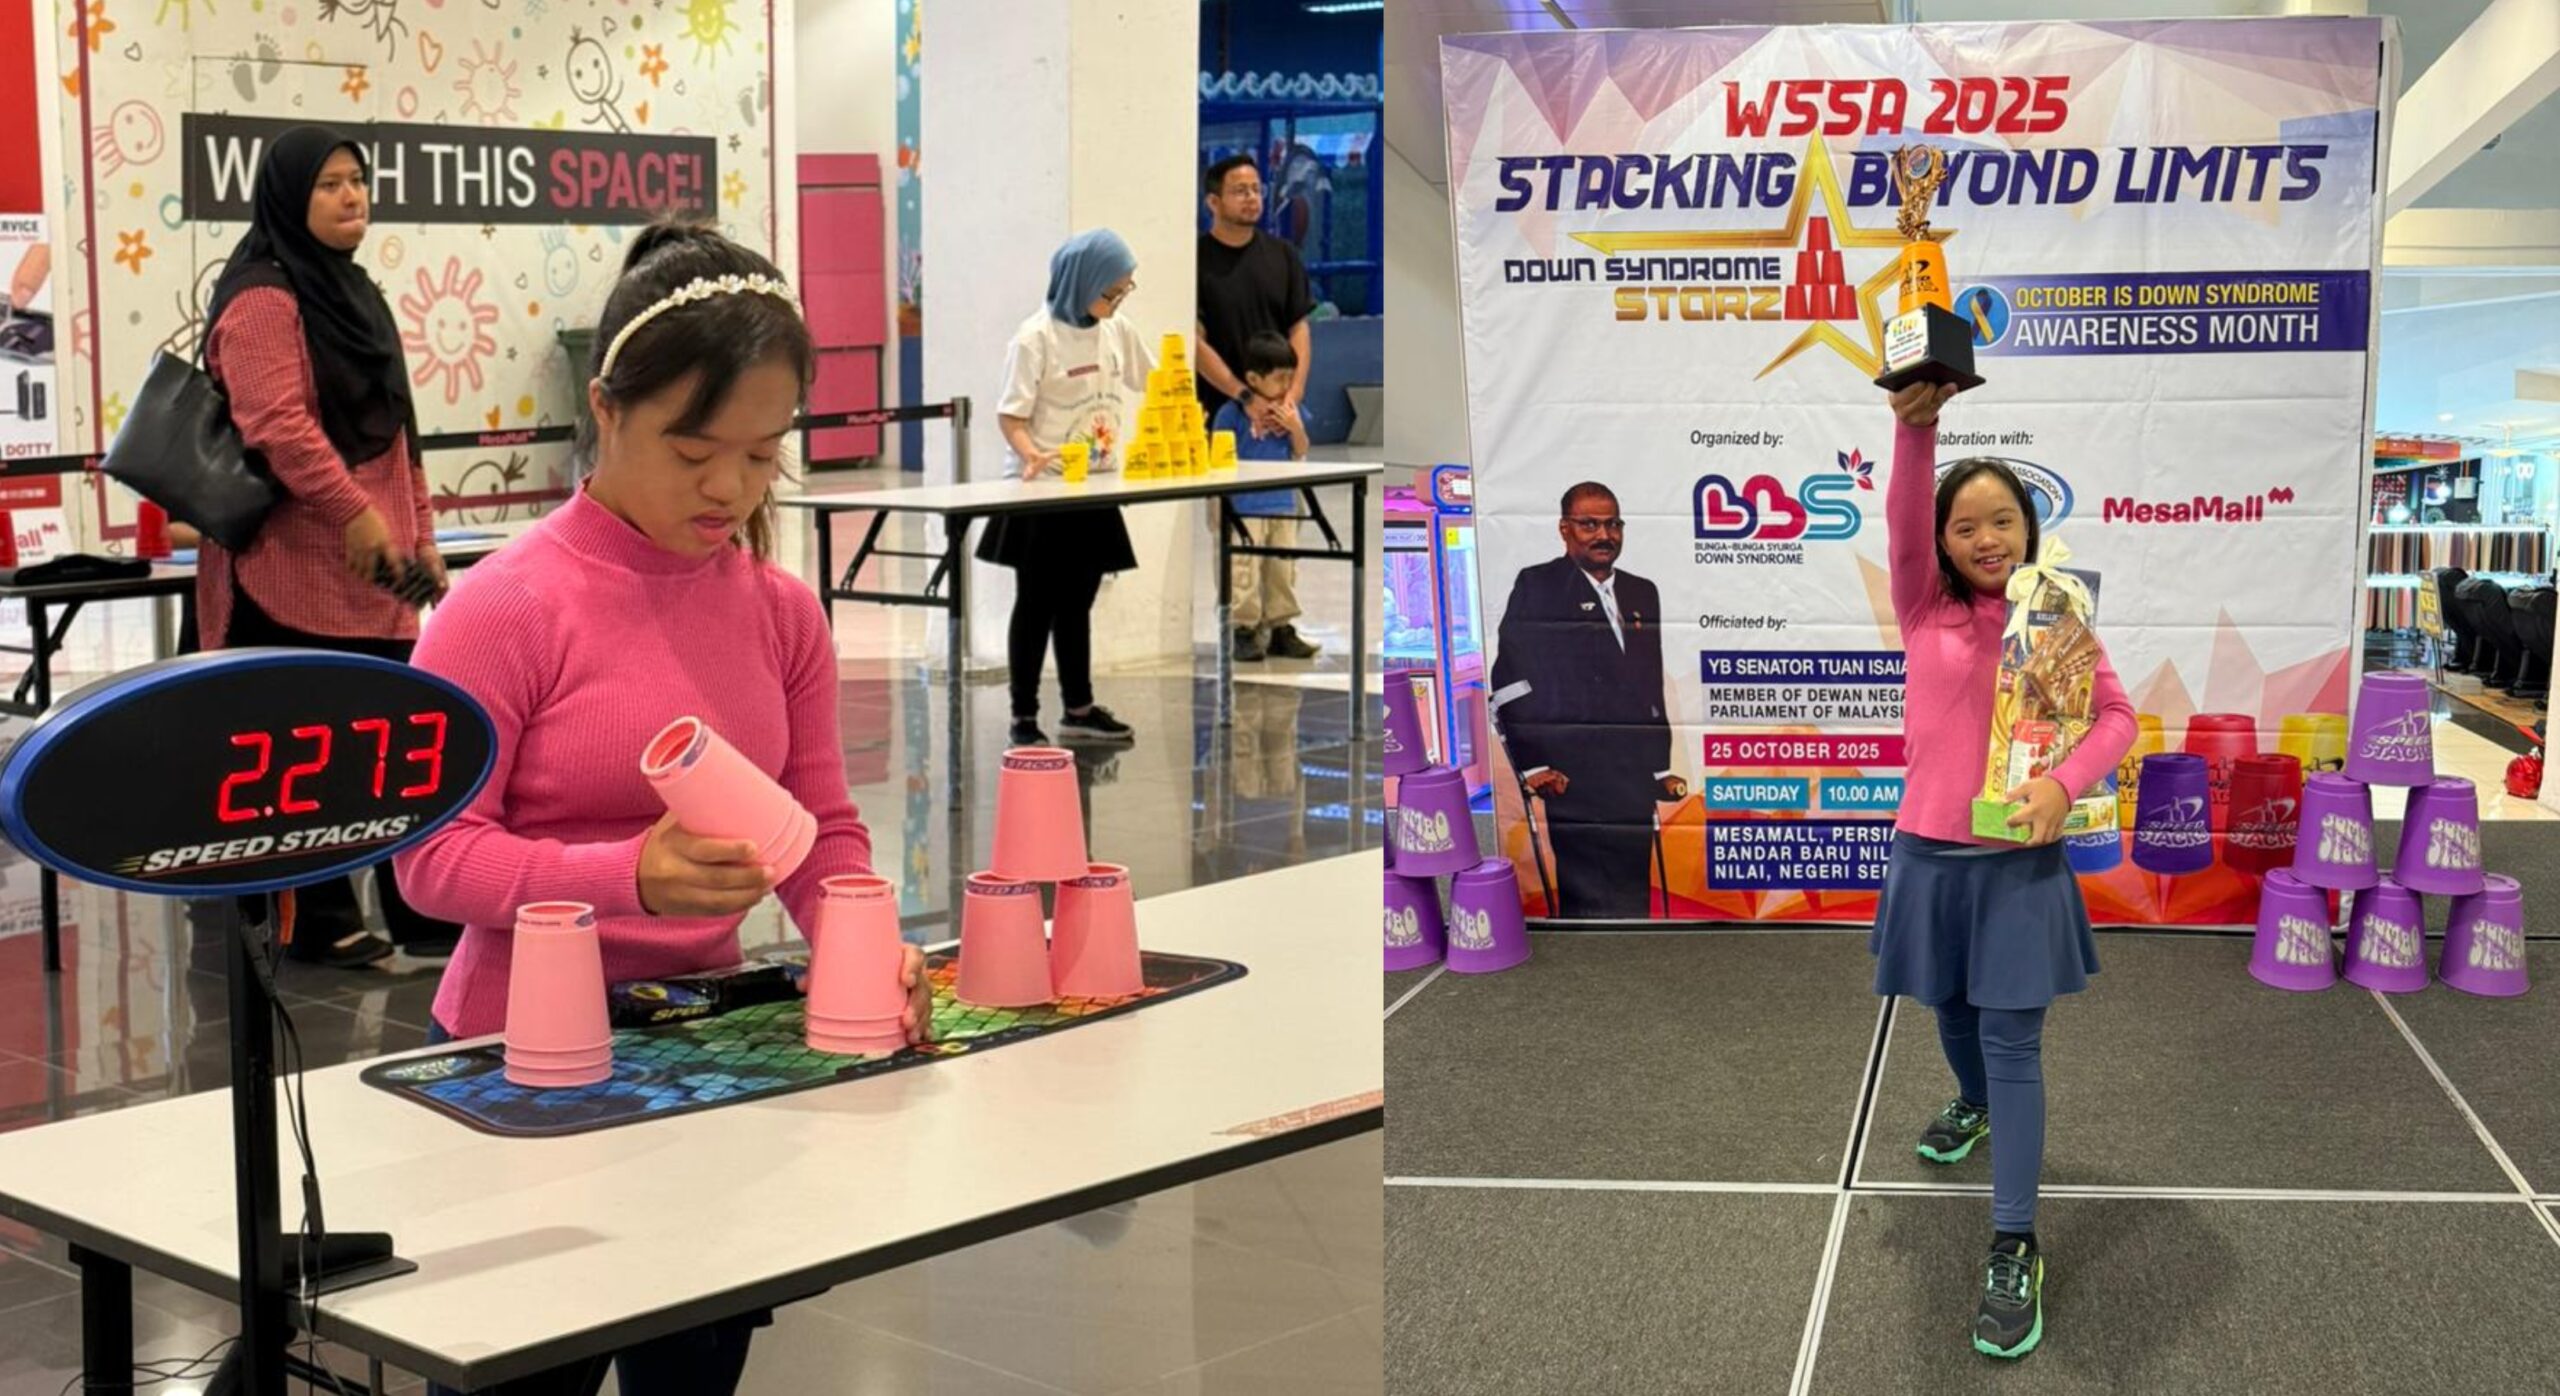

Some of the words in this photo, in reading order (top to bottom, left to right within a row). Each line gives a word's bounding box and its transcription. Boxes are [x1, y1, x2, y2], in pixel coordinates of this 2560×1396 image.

[1722, 78, 1910, 138] WSSA
[1923, 75, 2070, 135] 2025
[420, 142, 537, 208] THIS
[549, 148, 702, 208] SPACE!
[1495, 151, 1797, 212] STACKING
[2113, 144, 2328, 204] LIMITS
[1, 220, 39, 232] RVICE
[1504, 258, 1596, 283] DOWN
[1605, 256, 1781, 281] SYNDROME
[1614, 286, 1782, 321] STARZ
[2016, 286, 2107, 308] OCTOBER
[2113, 285, 2133, 306] IS
[2139, 284, 2200, 306] DOWN
[2205, 283, 2320, 305] SYNDROME
[2014, 315, 2199, 347] AWARENESS
[2208, 313, 2319, 344] MONTH
[1690, 430, 1760, 448] Organized
[1763, 430, 1784, 448] by:
[1999, 430, 2034, 445] with:
[5, 443, 52, 456] DOTTY
[2103, 495, 2264, 523] MesaMall
[1694, 542, 1764, 551] BUNGA-BUNGA
[1767, 542, 1804, 551] SYURGA
[1695, 553, 1734, 564] DOWN
[1736, 553, 1804, 564] SYNDROME
[1699, 614, 1764, 629] Officiated
[1767, 615, 1788, 632] by:
[1708, 658, 1731, 675] YB
[1736, 658, 1814, 675] SENATOR
[1818, 658, 1864, 675] TUAN
[1710, 688, 1776, 702] MEMBER
[1782, 688, 1802, 702] OF
[1808, 688, 1862, 702] DEWAN
[1711, 705, 1808, 719] PARLIAMENT
[1813, 705, 1833, 719] OF
[1711, 742, 1733, 759] 25
[1739, 742, 1831, 759] OCTOBER
[1837, 742, 1880, 759] 2025
[217, 712, 447, 823] 2.273
[1713, 784, 1800, 802] SATURDAY
[1828, 784, 1869, 802] 10.00
[1872, 784, 1899, 802] AM
[145, 835, 275, 872] SPEED
[277, 816, 411, 852] STACKS
[1714, 827, 1824, 844] MESAMALL,
[2138, 830, 2211, 848] STACKS
[1714, 846, 1792, 861] BANDAR
[1800, 846, 1851, 861] BARU
[1715, 864, 1771, 882] NILAI,
[1780, 864, 1849, 879] NEGERI
